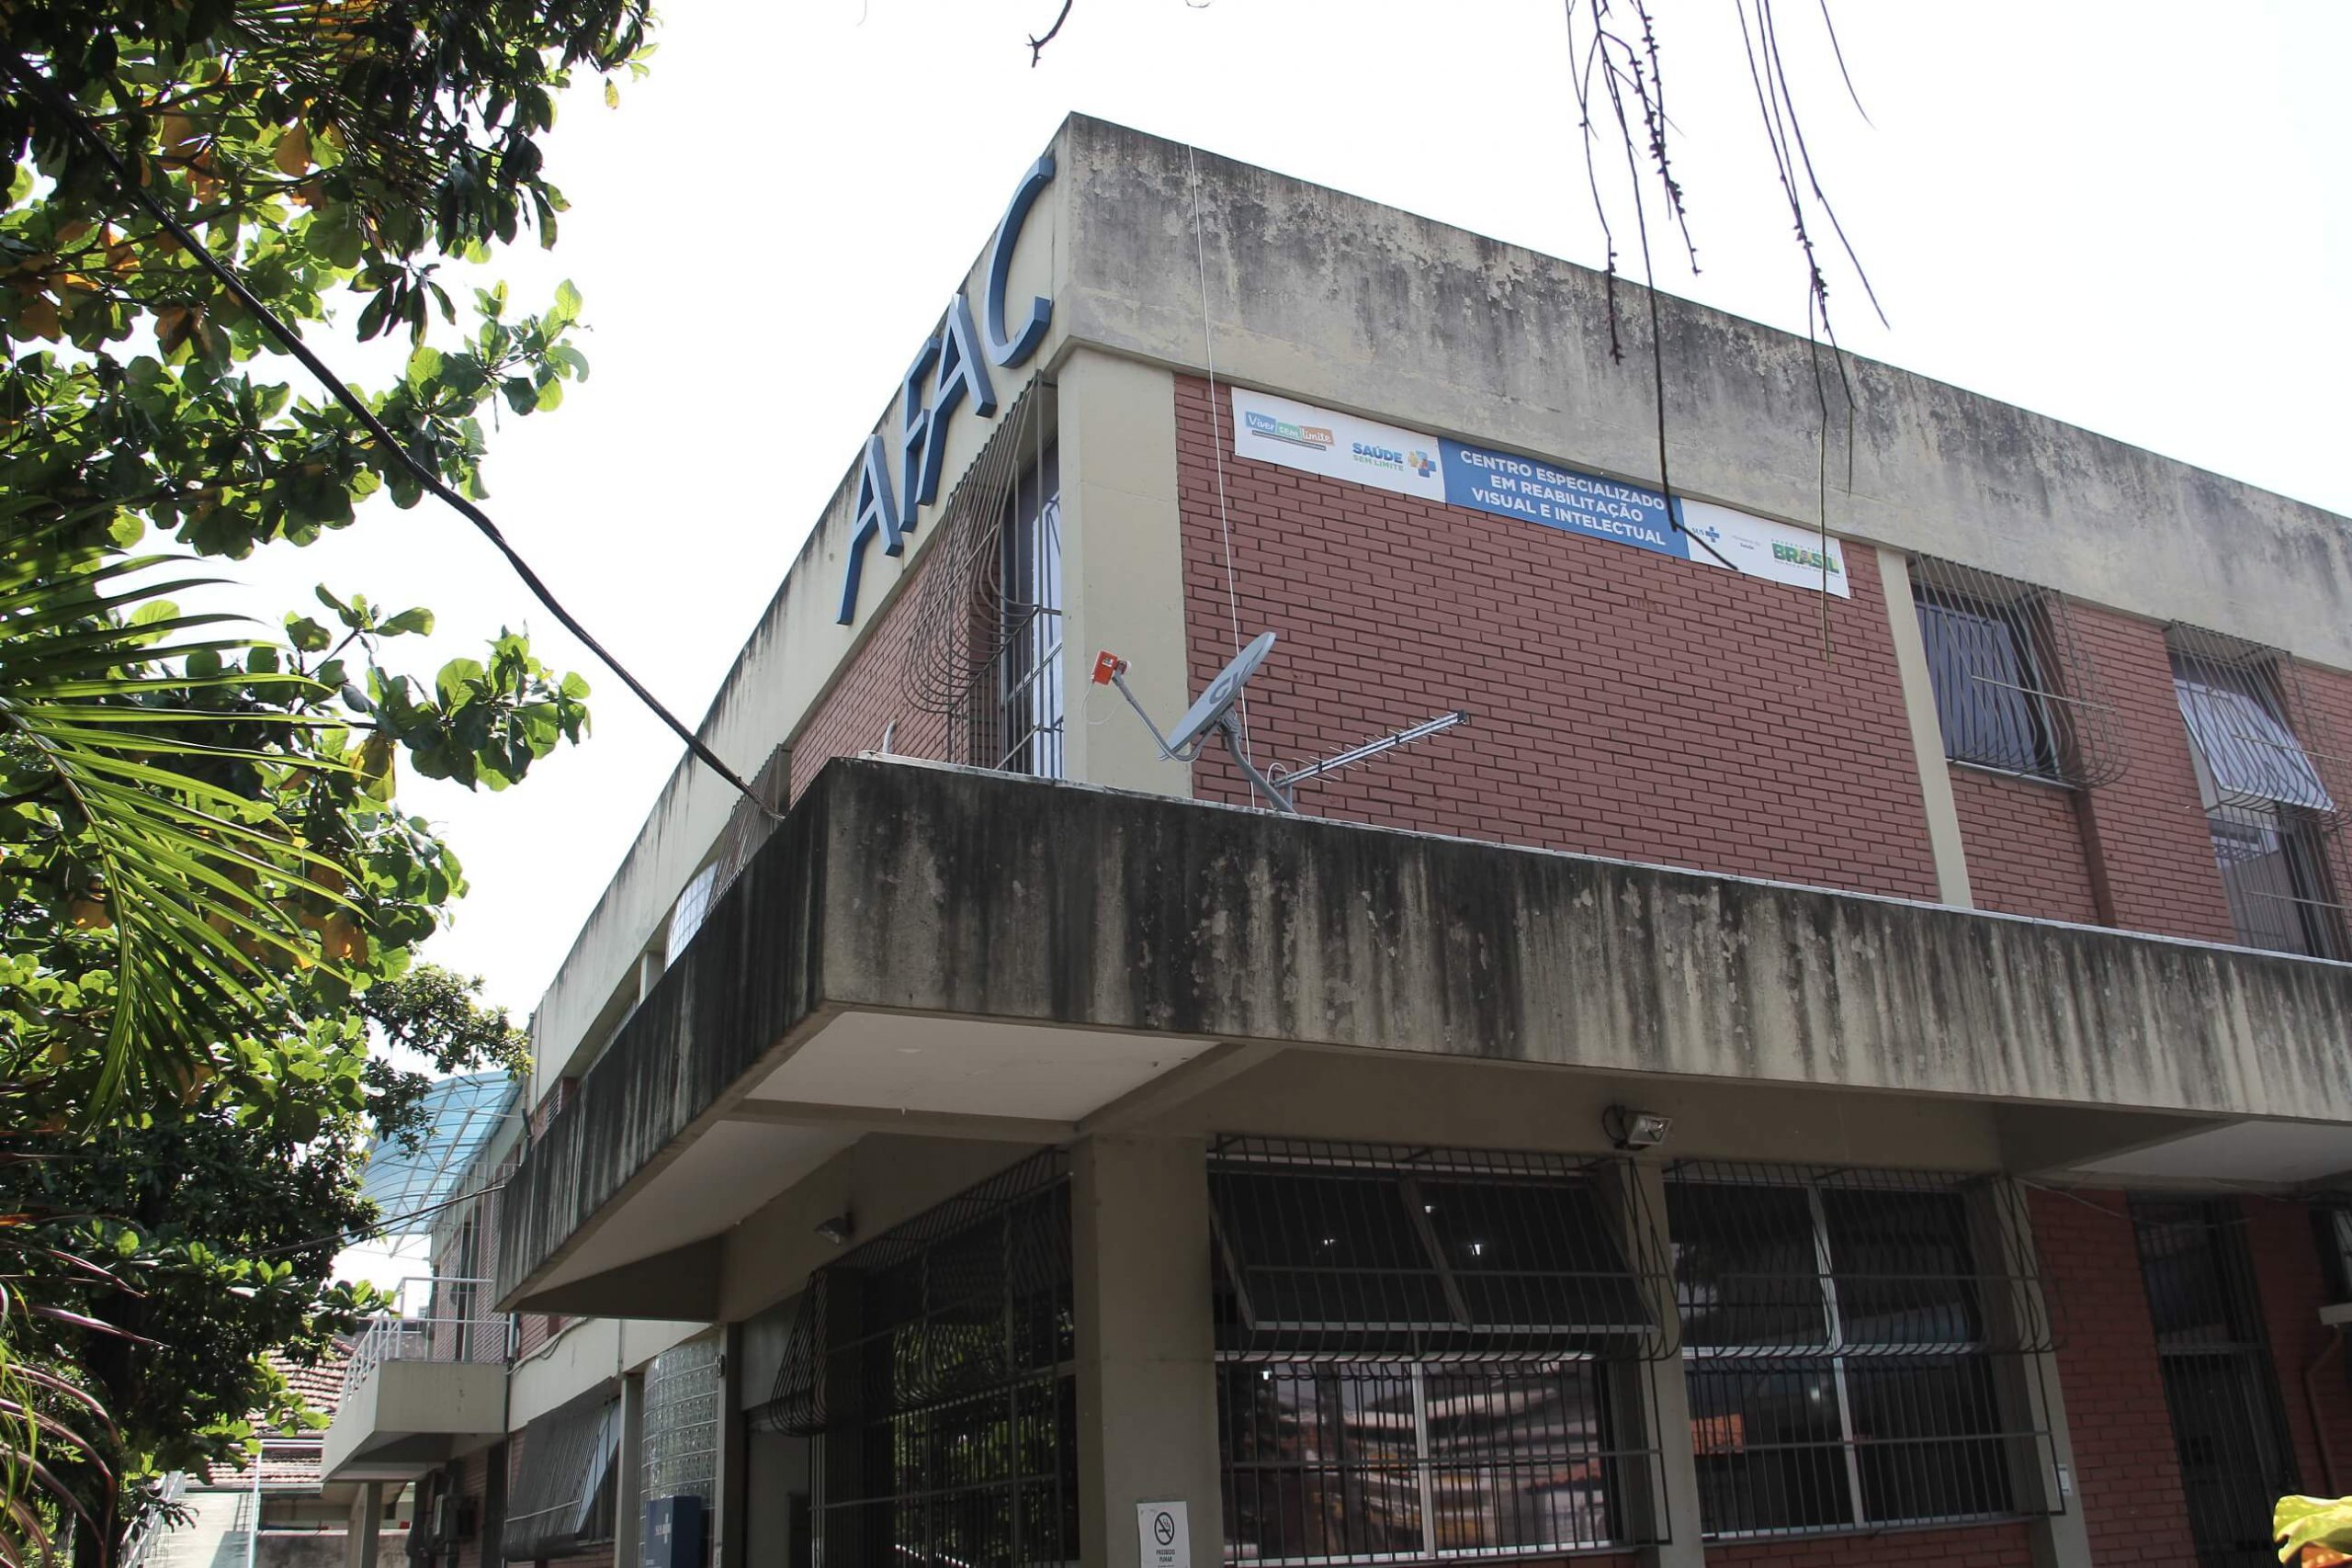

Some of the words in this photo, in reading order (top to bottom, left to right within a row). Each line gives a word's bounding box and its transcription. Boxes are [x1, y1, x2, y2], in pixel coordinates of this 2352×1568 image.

[836, 154, 1056, 625] AFAC
[1249, 414, 1273, 431] Viver
[1279, 426, 1298, 437] sem
[1300, 427, 1331, 443] limite
[1352, 442, 1403, 464] SAÚDE
[1460, 450, 1532, 478] CENTRO
[1536, 468, 1666, 511] ESPECIALIZADO
[1490, 474, 1517, 491] EM
[1521, 480, 1644, 523] REABILITAÇÃO
[1471, 488, 1537, 514] VISUAL
[1540, 503, 1552, 518] E
[1555, 507, 1667, 546] INTELECTUAL
[1771, 543, 1840, 574] BRASIL
